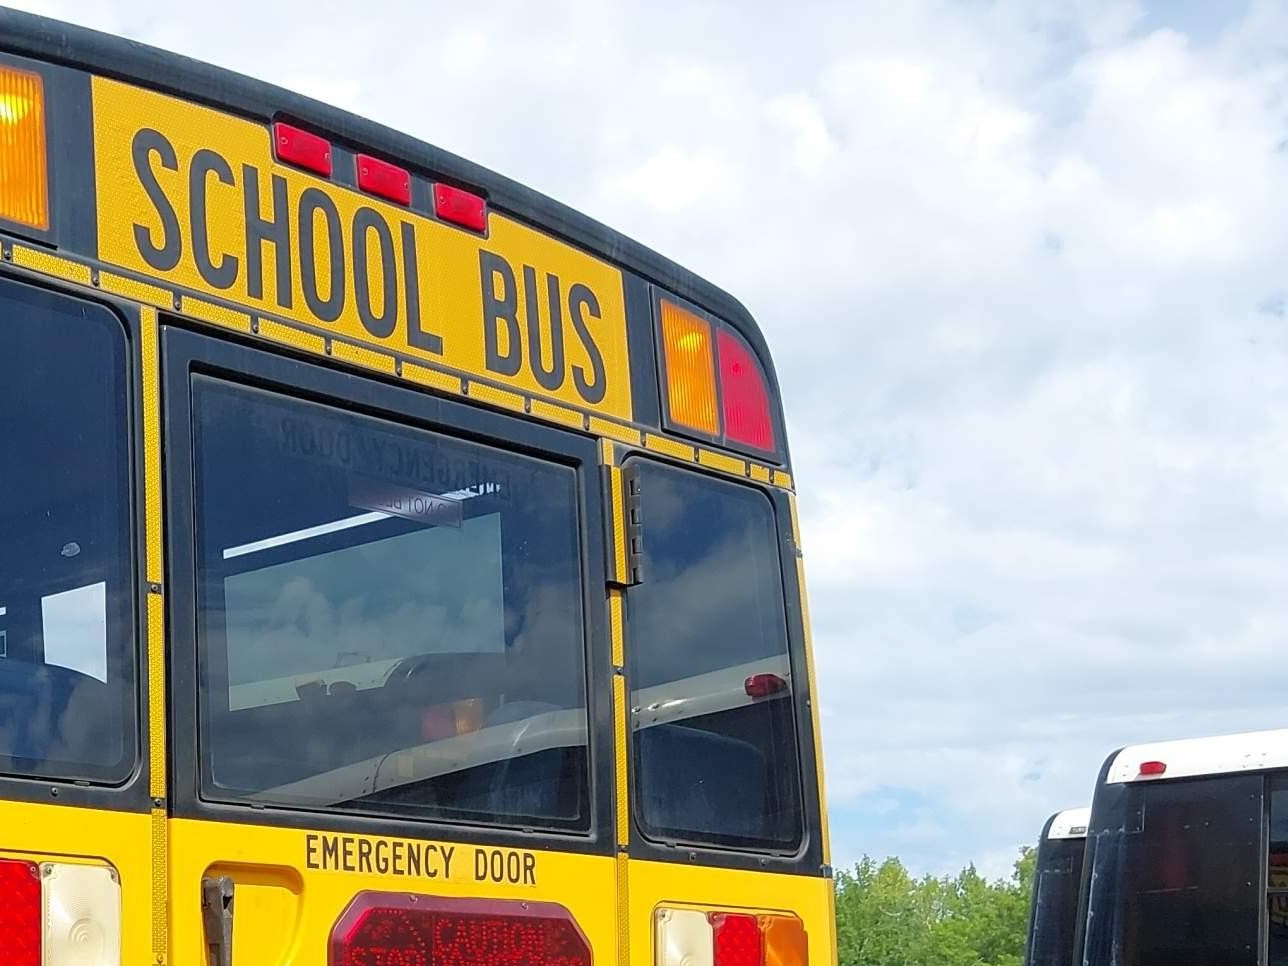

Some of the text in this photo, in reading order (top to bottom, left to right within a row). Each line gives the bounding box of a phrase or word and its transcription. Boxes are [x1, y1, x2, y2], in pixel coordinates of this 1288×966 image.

[131, 128, 607, 405] SCHOOL BUS
[305, 834, 537, 885] EMERGENCY DOOR
[435, 918, 544, 954] CAUTION
